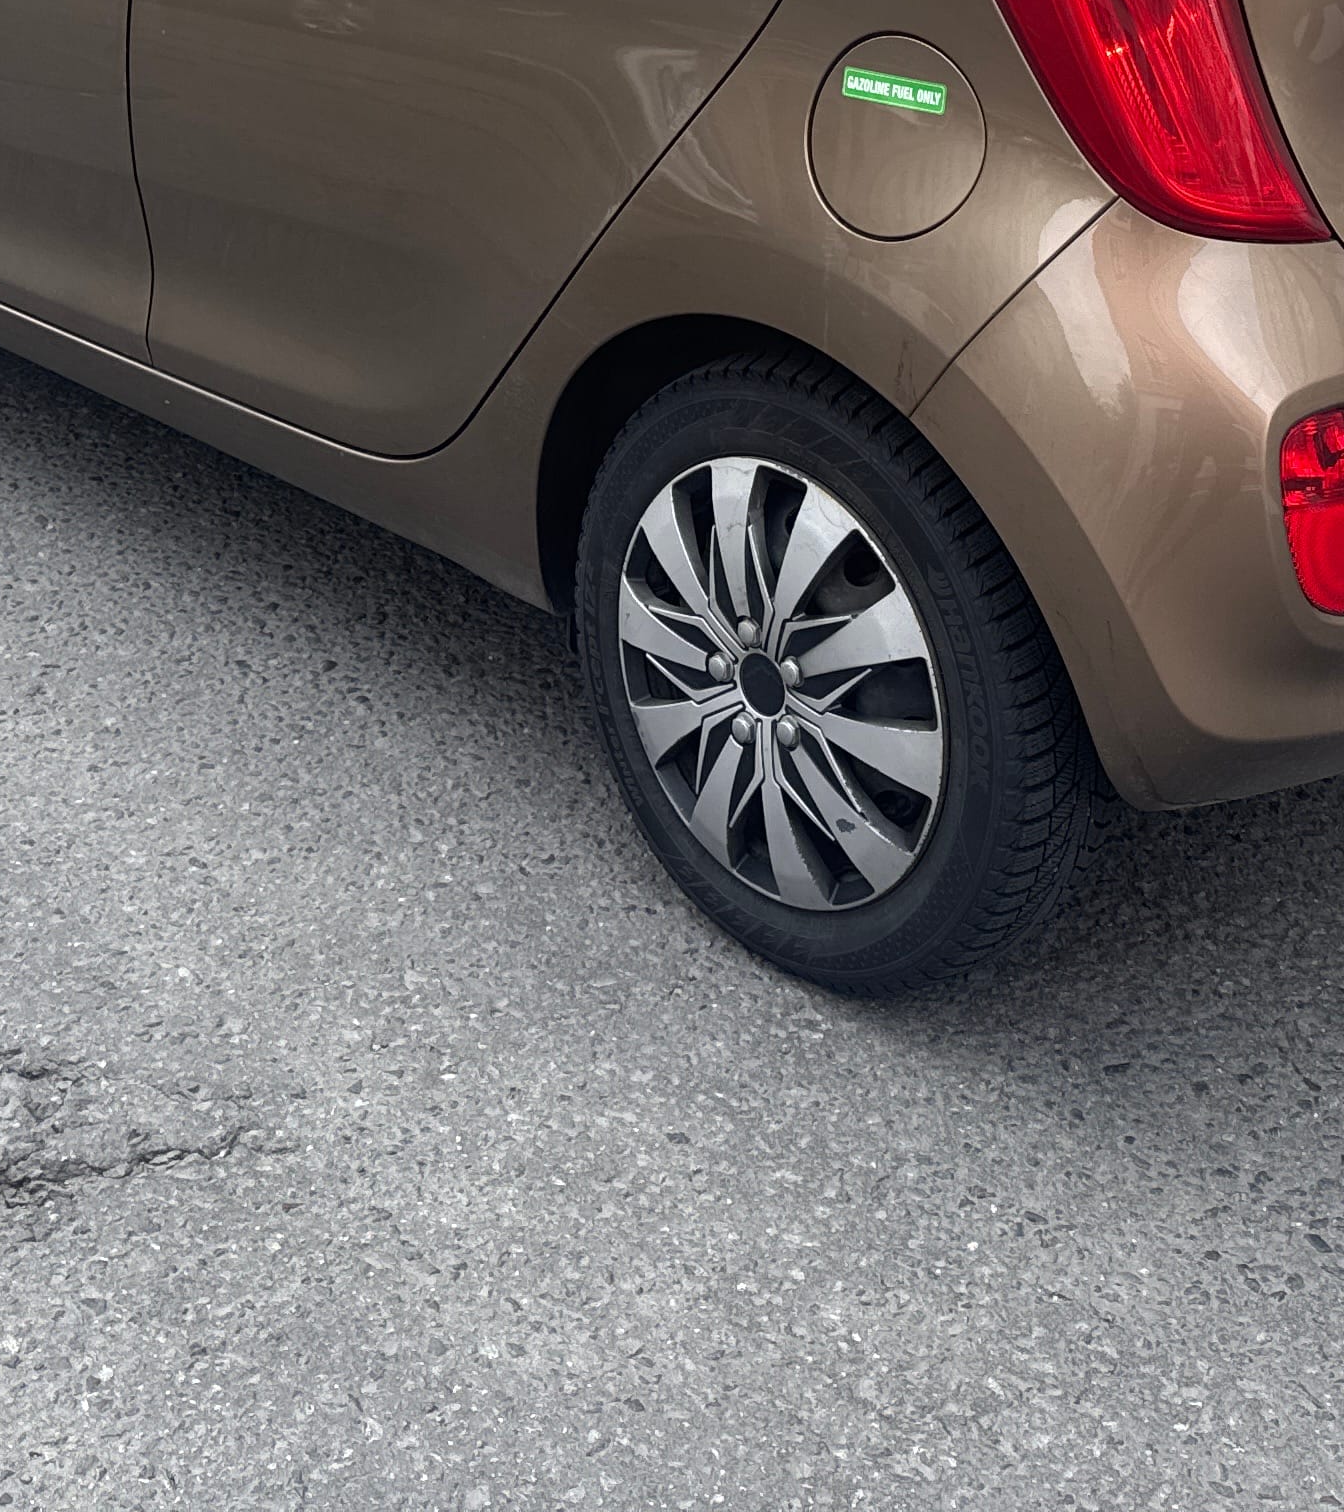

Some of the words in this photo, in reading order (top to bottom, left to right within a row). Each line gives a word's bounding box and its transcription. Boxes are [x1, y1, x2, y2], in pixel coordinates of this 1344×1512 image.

[847, 75, 890, 97] GAZOLINE
[891, 84, 915, 102] FUEL
[916, 88, 942, 106] ONLY
